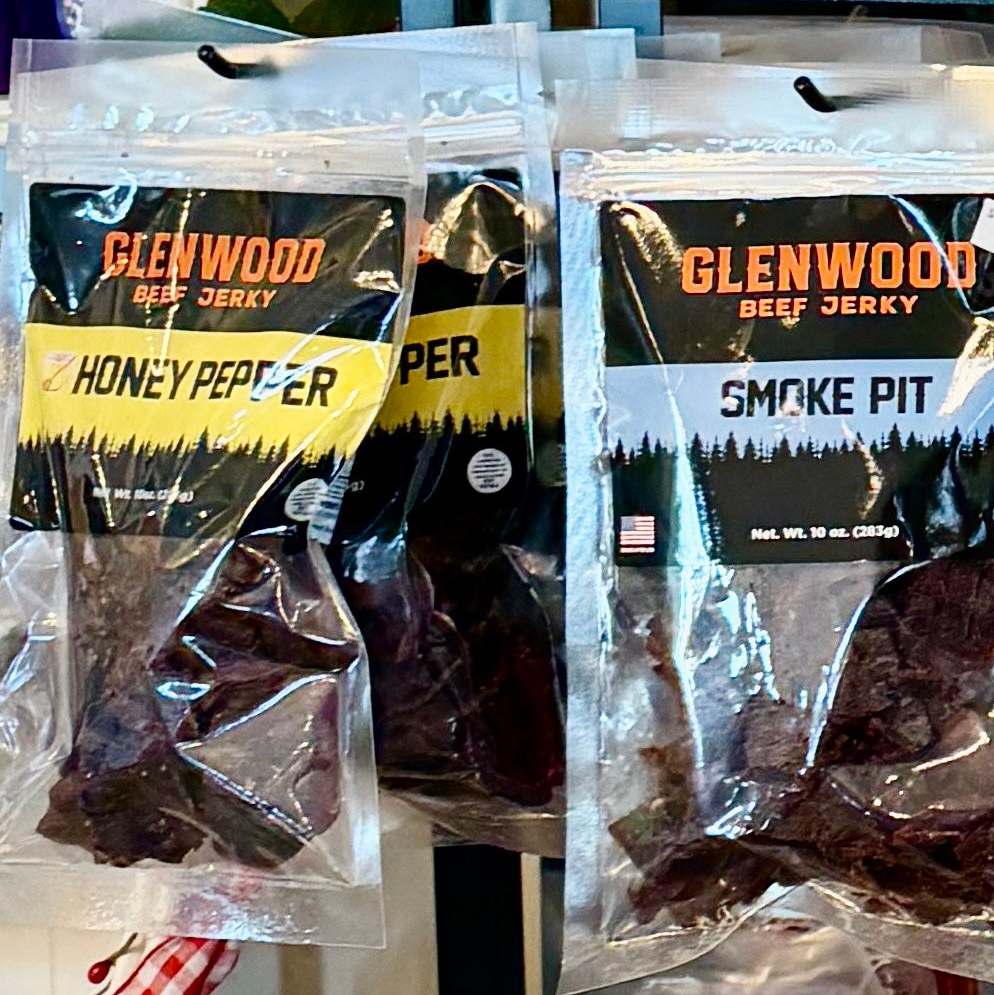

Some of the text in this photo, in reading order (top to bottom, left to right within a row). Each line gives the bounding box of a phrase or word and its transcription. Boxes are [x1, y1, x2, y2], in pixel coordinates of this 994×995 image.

[102, 231, 326, 284] GLENWOOD
[680, 241, 977, 294] GLENWOOD
[132, 284, 277, 308] BEEF JERKY
[739, 295, 918, 318] BEEF JERKY
[72, 354, 338, 407] HONEY PEPPER
[400, 334, 480, 386] PER
[721, 376, 933, 418] SMOKE PIT
[157, 489, 194, 503] (2g)
[751, 525, 899, 540] Net. Wt. 10 oz. (283g)
